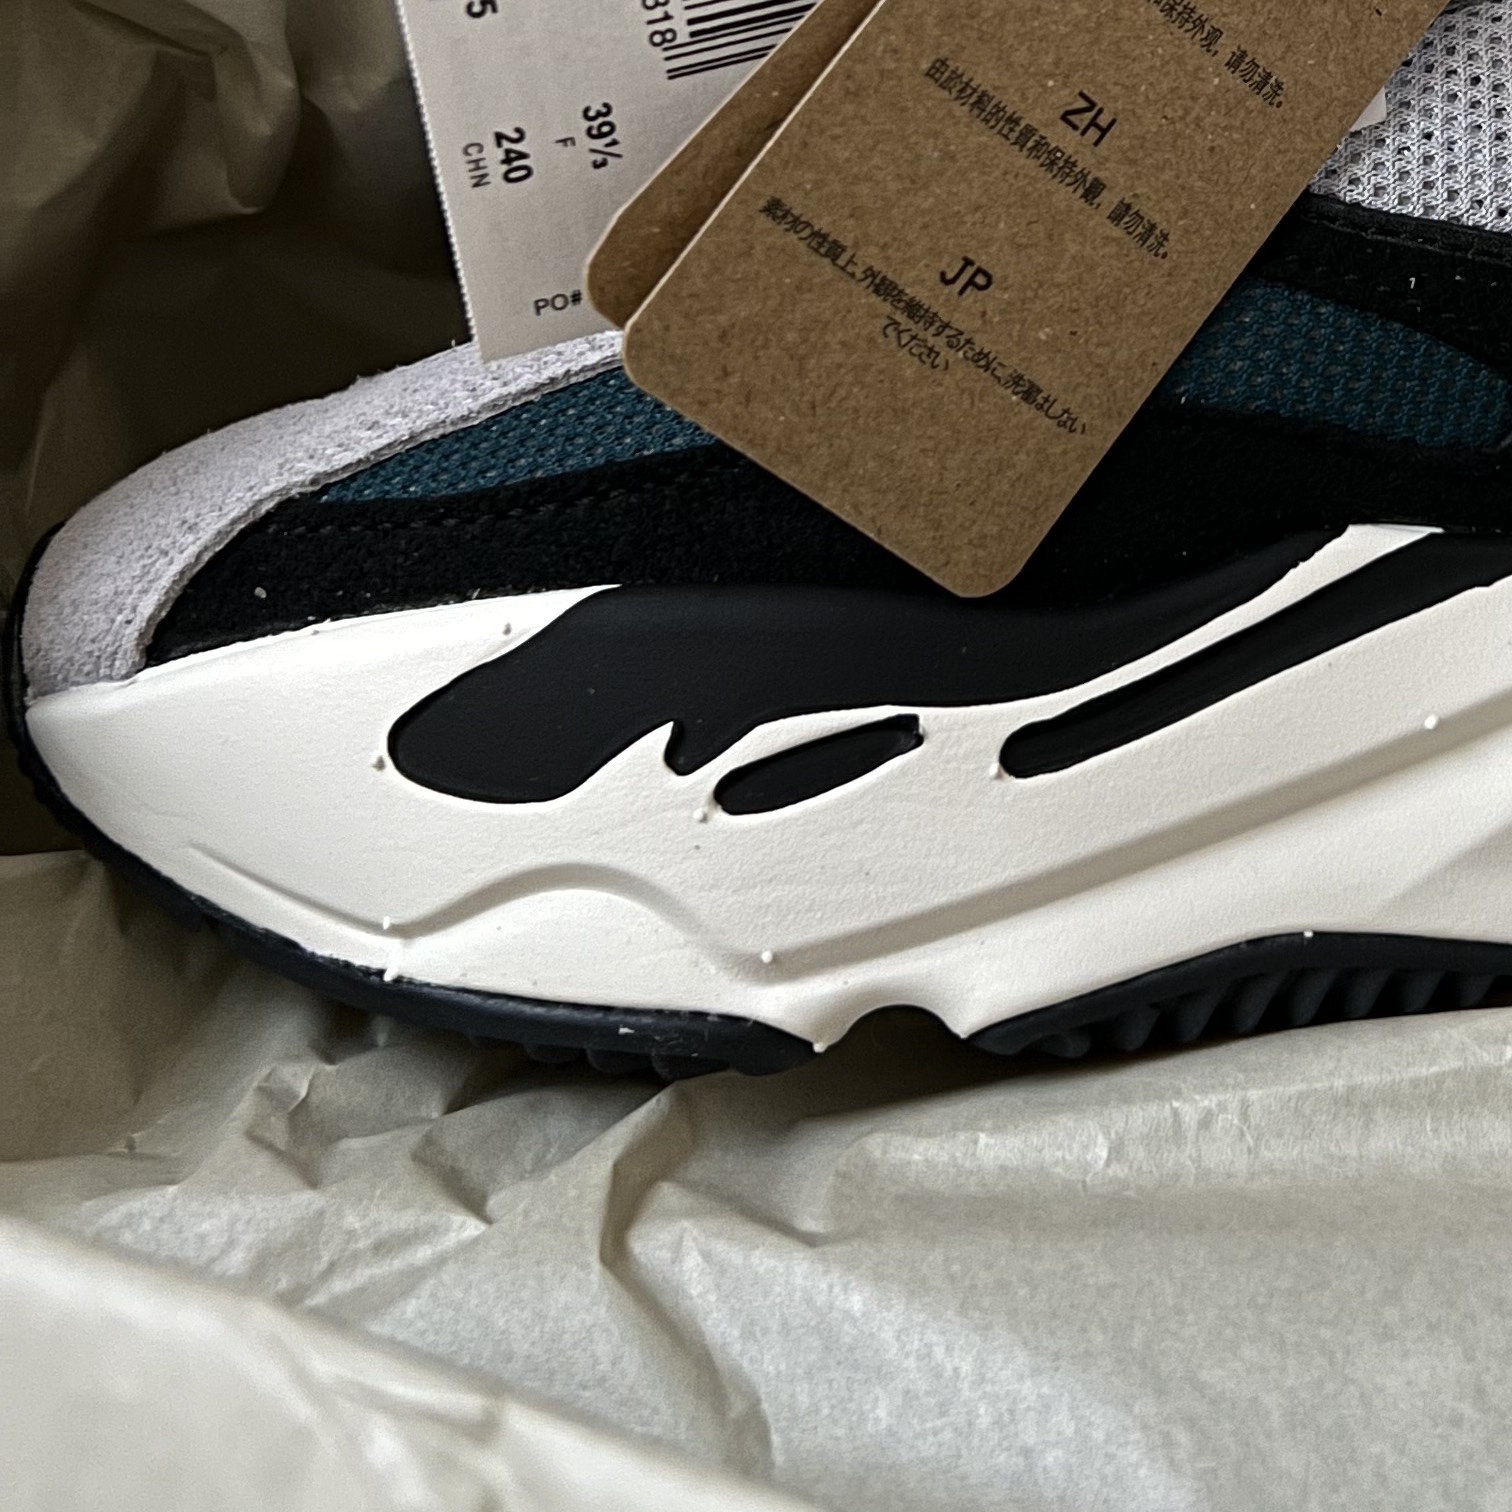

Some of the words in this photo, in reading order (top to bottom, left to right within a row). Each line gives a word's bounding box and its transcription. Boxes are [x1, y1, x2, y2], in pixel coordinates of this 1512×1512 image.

[553, 136, 577, 148] F
[1059, 90, 1118, 148] ZH
[461, 141, 492, 189] CHN
[493, 126, 534, 184] 240
[939, 255, 993, 297] JP
[533, 289, 583, 317] PO#
[882, 314, 949, 372] でください
